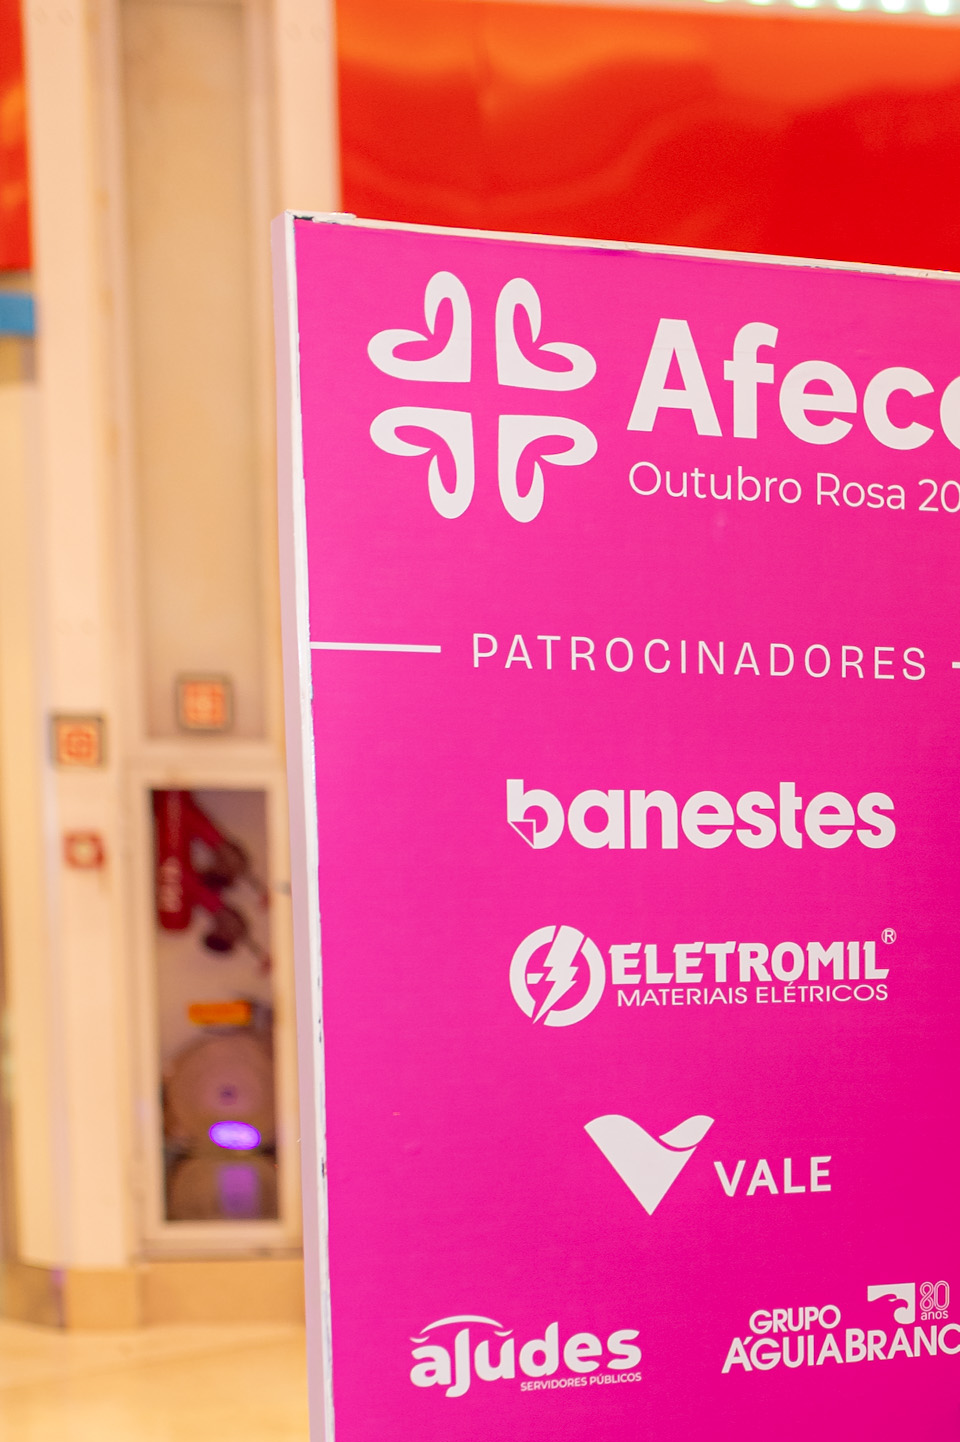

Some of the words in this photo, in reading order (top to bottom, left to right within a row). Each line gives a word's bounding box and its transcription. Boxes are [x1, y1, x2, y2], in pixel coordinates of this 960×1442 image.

[628, 461, 802, 504] Outubro
[816, 472, 907, 511] Rosa
[472, 632, 927, 680] PATROCINADORES
[506, 779, 896, 849] banestes
[618, 987, 747, 1007] MATERIAIS
[756, 982, 888, 1004] ELÉTRICOS
[713, 1155, 832, 1197] VALE
[919, 1280, 950, 1311] 80
[749, 1304, 841, 1335] GRUPO
[920, 1309, 949, 1321] anos
[520, 1377, 587, 1392] SERVIDORES
[589, 1372, 642, 1385] PÚBLICOS
